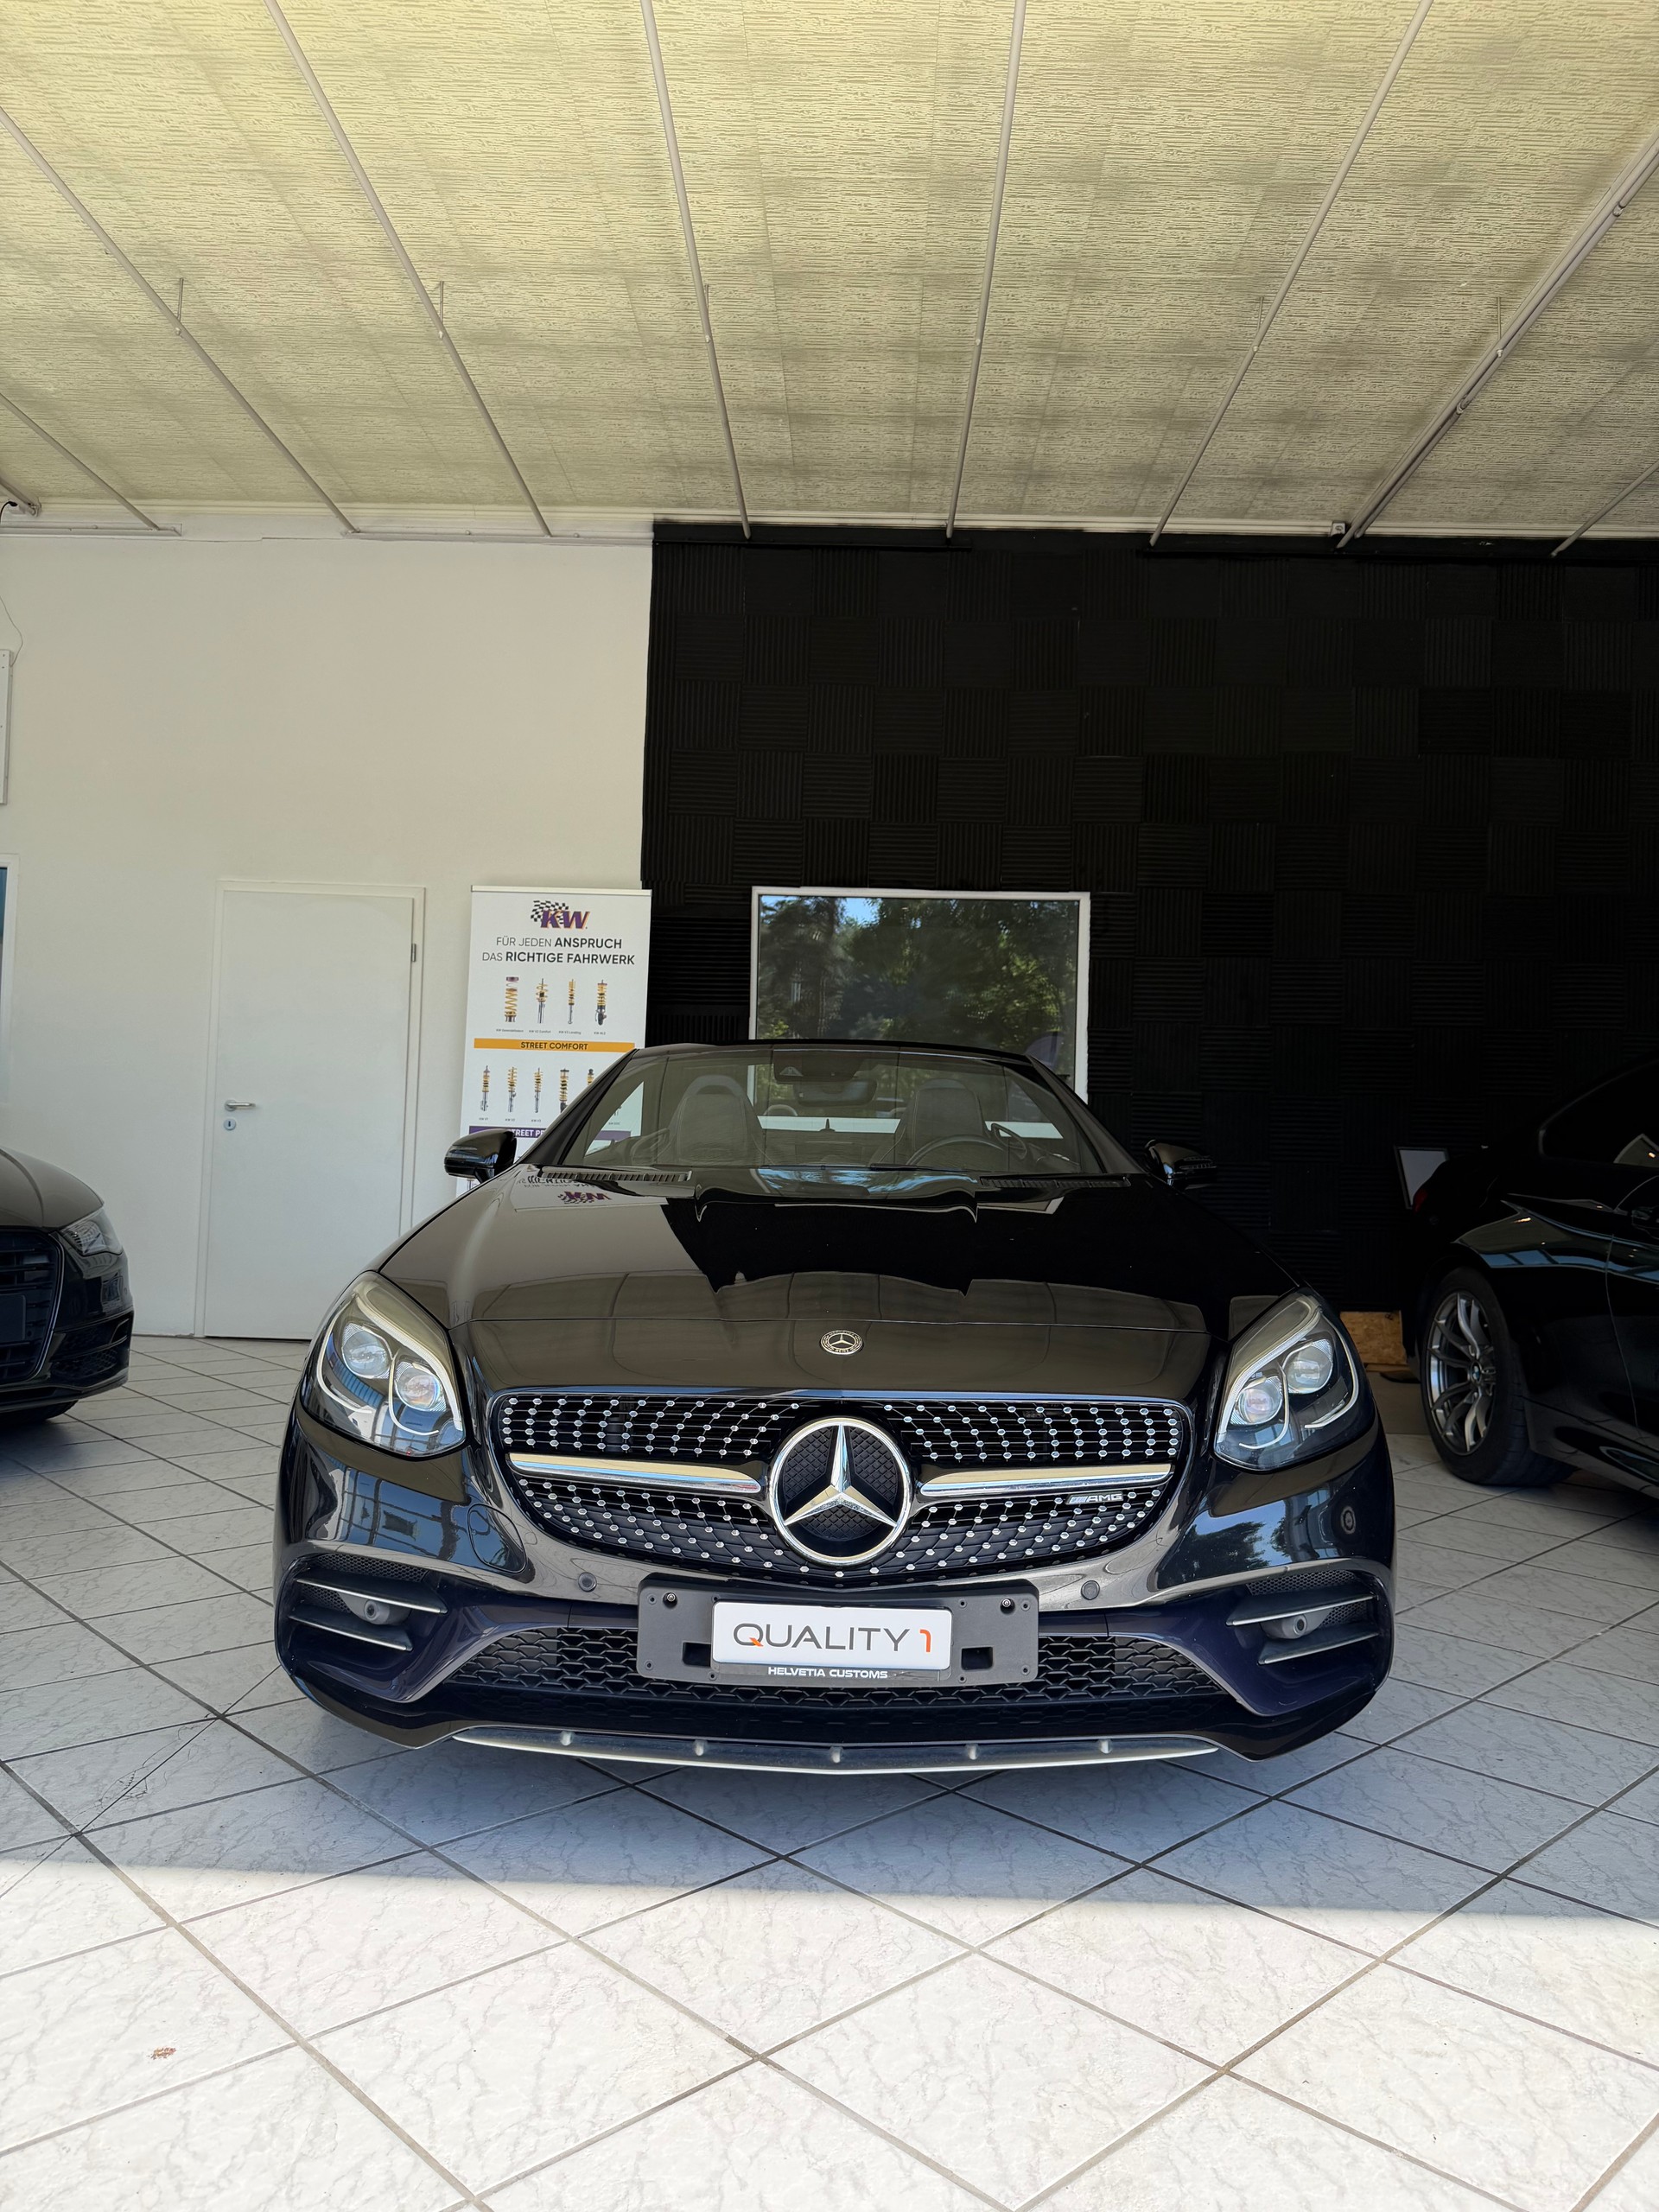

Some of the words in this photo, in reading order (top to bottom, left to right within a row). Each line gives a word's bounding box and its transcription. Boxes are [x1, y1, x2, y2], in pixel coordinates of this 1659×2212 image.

[540, 909, 590, 930] KW
[496, 936, 517, 946] FÜR
[518, 938, 552, 947] JEDEN
[554, 938, 622, 949] ANSPRUCH
[482, 952, 503, 962] DAS
[505, 951, 563, 963] RICHTIGE
[567, 953, 635, 965] FAHRWERK
[520, 1041, 548, 1050] STREET
[549, 1042, 588, 1051] COMFORT
[511, 1128, 535, 1137] TREET
[733, 1623, 911, 1652] QUALITY
[919, 1629, 931, 1653] 1
[767, 1666, 826, 1677] HELVETIA
[829, 1669, 888, 1679] CUSTOMS
